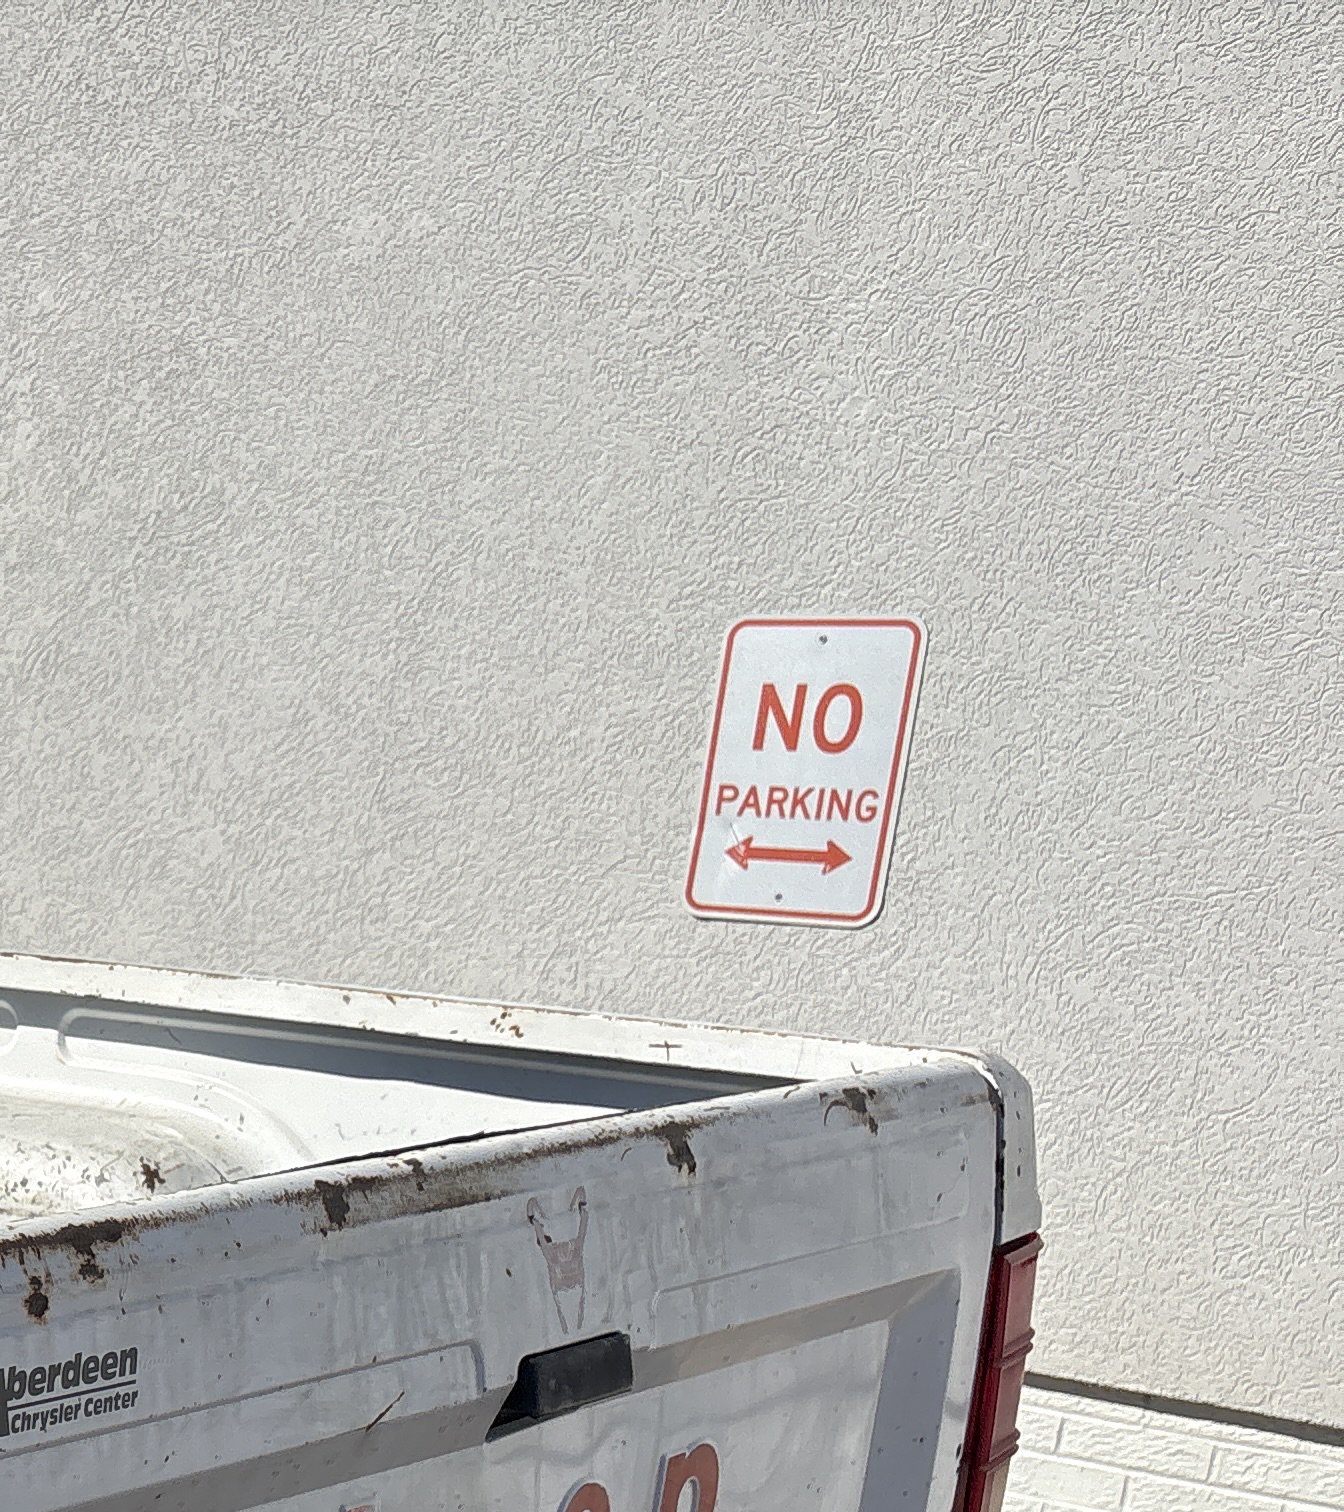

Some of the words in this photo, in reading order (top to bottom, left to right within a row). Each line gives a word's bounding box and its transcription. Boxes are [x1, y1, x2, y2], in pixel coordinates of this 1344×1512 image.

[752, 682, 864, 755] NO
[715, 784, 881, 824] PARKING
[11, 1398, 82, 1434] Chrysler
[84, 1390, 139, 1418] Center
